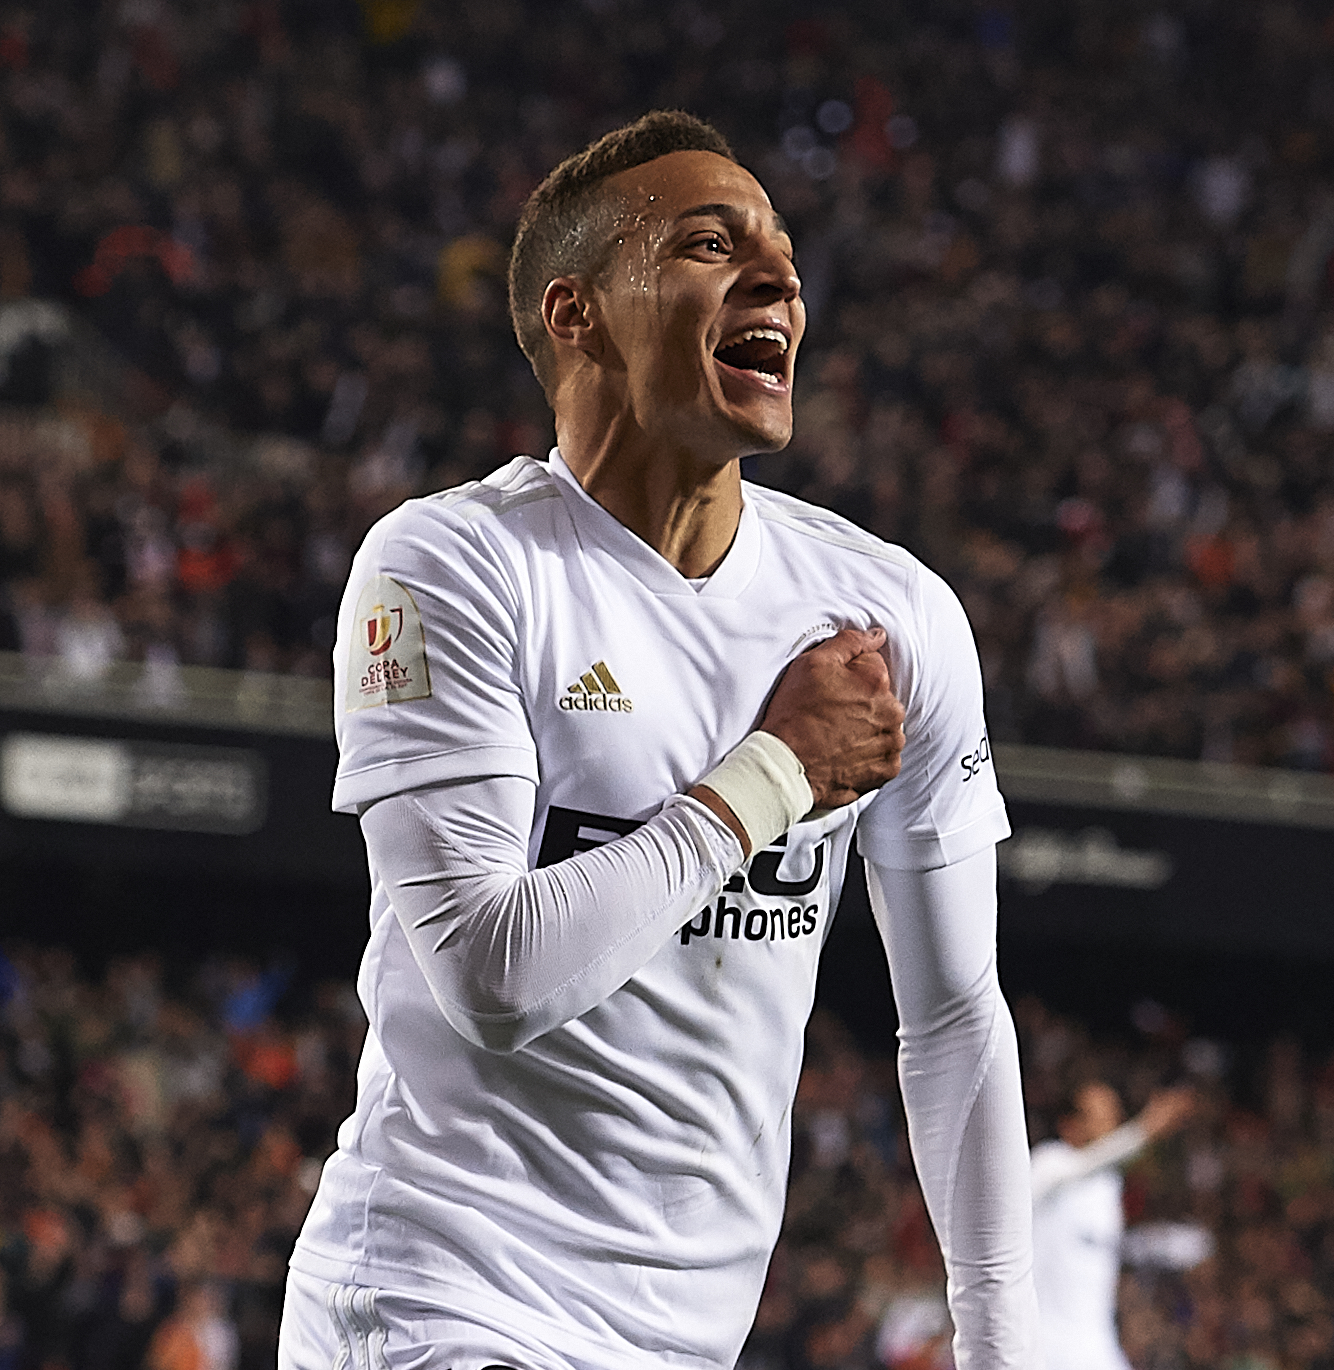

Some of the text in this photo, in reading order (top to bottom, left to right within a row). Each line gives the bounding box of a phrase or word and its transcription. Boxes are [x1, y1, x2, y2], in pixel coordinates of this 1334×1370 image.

[361, 673, 382, 687] DEL
[383, 666, 409, 680] REY
[367, 659, 399, 675] COPA
[559, 692, 633, 713] adidas
[675, 896, 819, 945] phones
